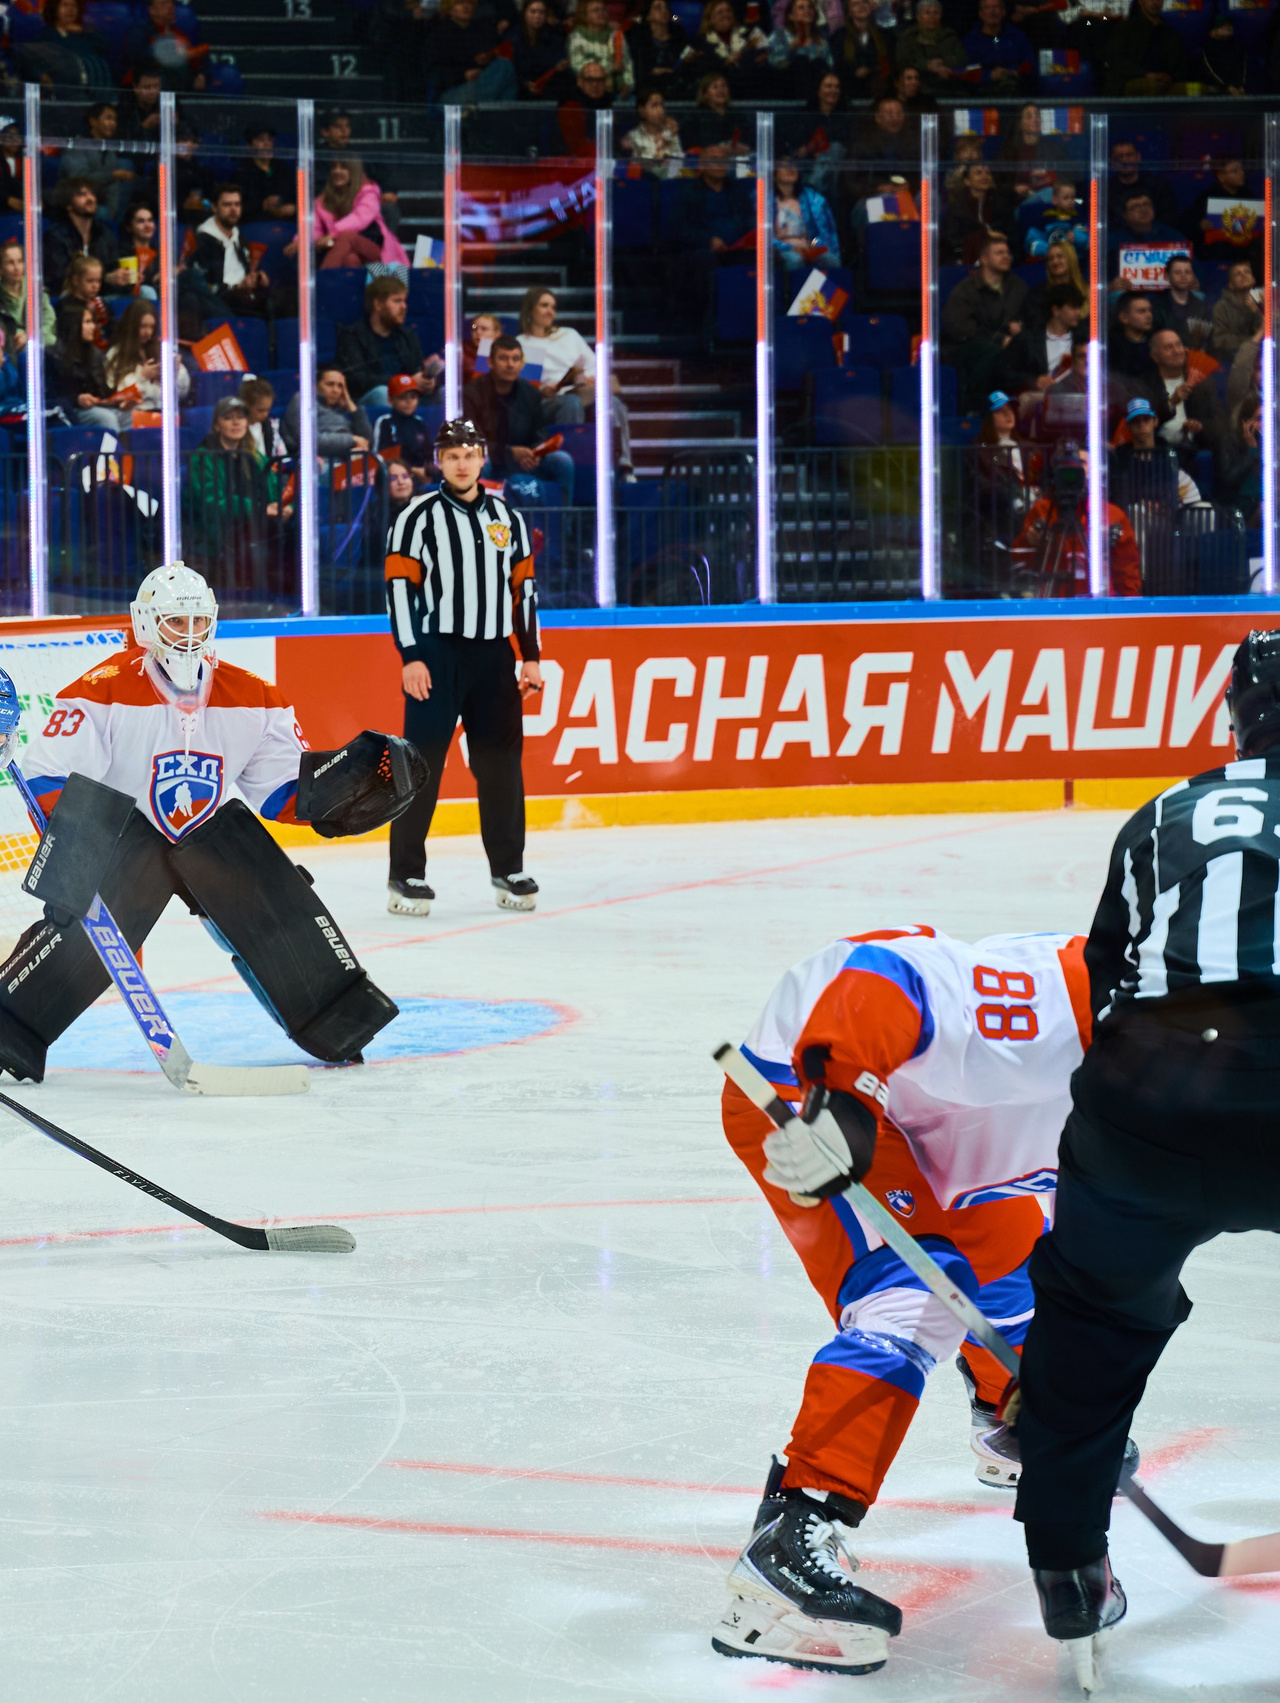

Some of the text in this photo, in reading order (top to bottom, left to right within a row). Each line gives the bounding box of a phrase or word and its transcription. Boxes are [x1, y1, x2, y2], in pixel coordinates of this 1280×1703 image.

[286, 0, 312, 18] 13
[331, 54, 358, 77] 12
[379, 118, 401, 140] 11
[42, 708, 86, 738] 83
[447, 652, 914, 767] РАСНАЯ
[156, 754, 220, 783] СХЛ
[313, 749, 348, 779] BAUER
[27, 832, 57, 891] BAUER
[314, 915, 357, 971] BAUER
[7, 932, 63, 995] BAUER
[91, 925, 171, 1038] BAUER
[971, 963, 1040, 1042] 88
[112, 1170, 172, 1202] FLYLITE
